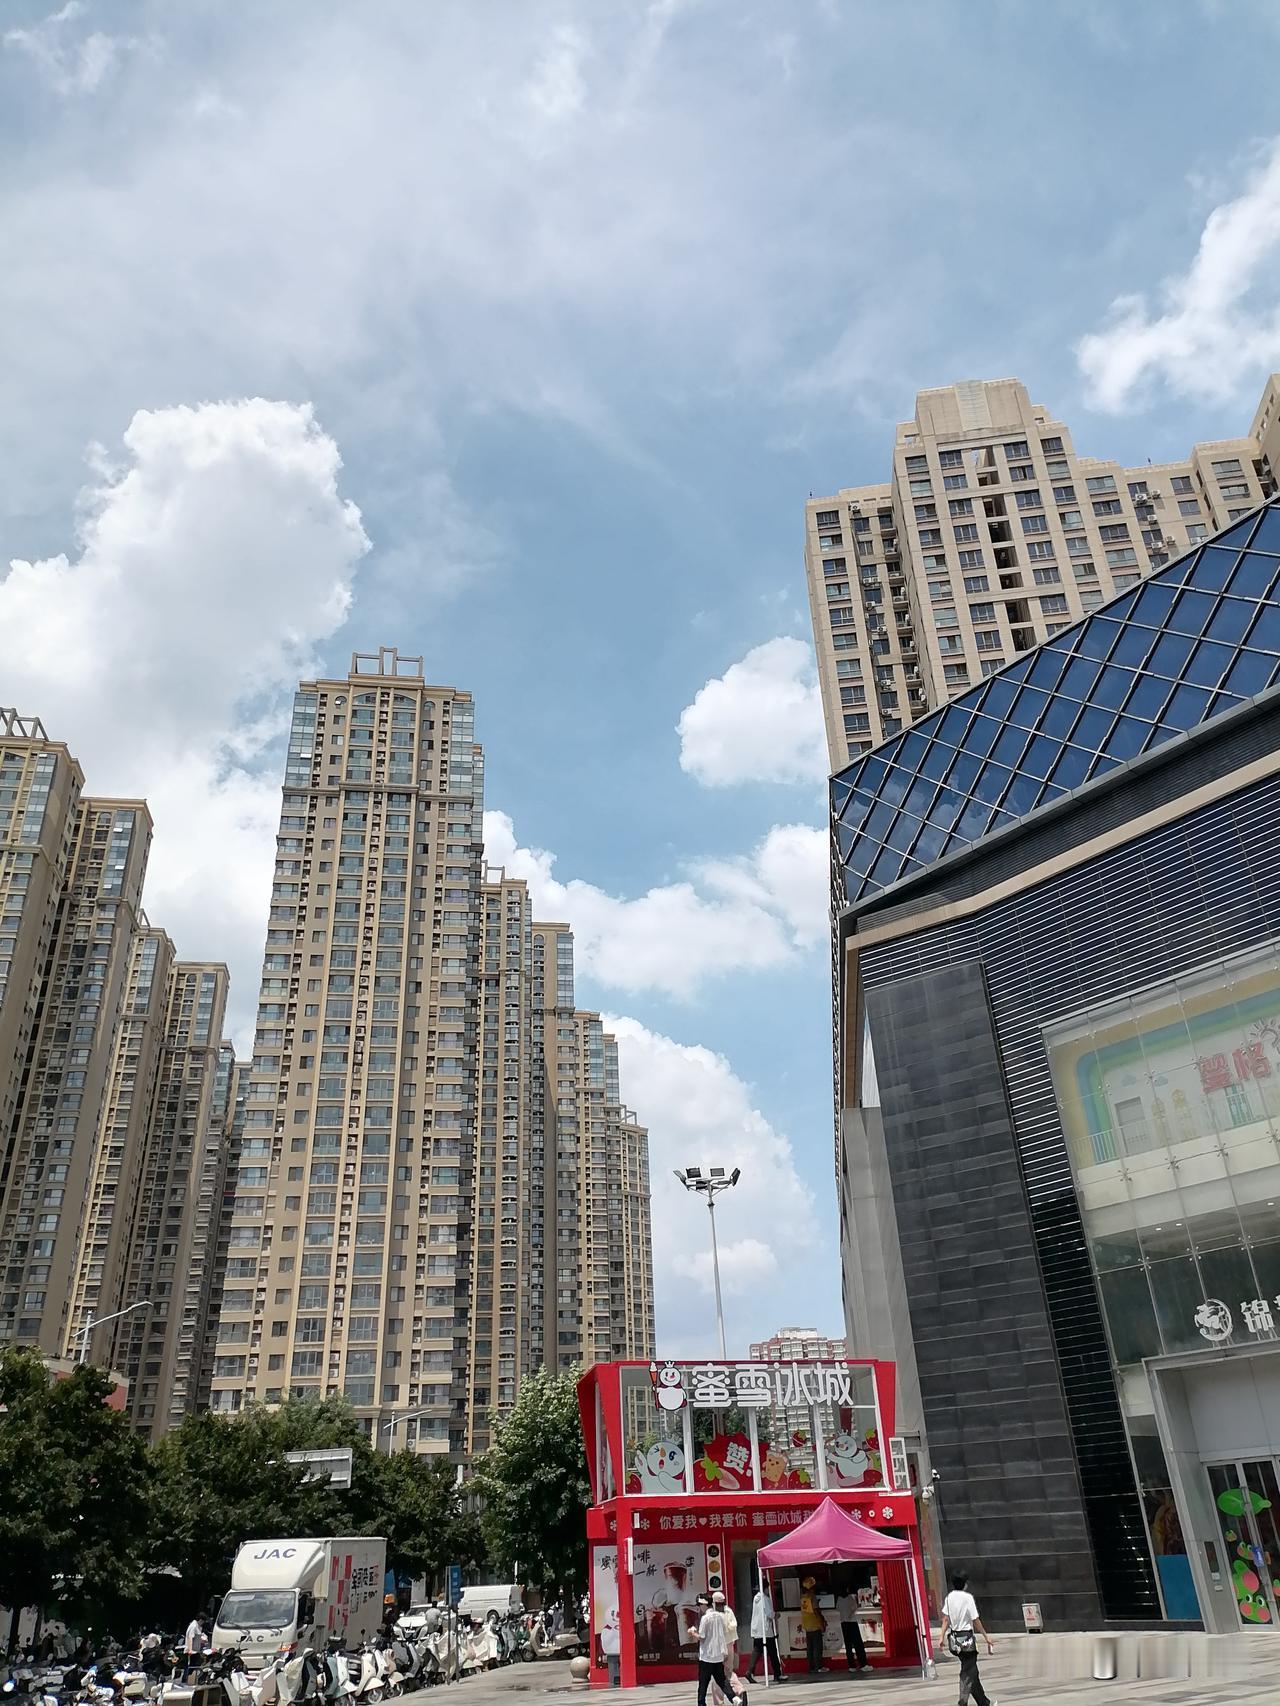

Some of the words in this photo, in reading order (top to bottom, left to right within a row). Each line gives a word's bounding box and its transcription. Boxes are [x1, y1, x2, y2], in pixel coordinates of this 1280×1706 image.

[1240, 1295, 1280, 1333] 锦
[692, 1362, 853, 1407] 蜜雪冰城
[254, 1548, 297, 1559] JAC
